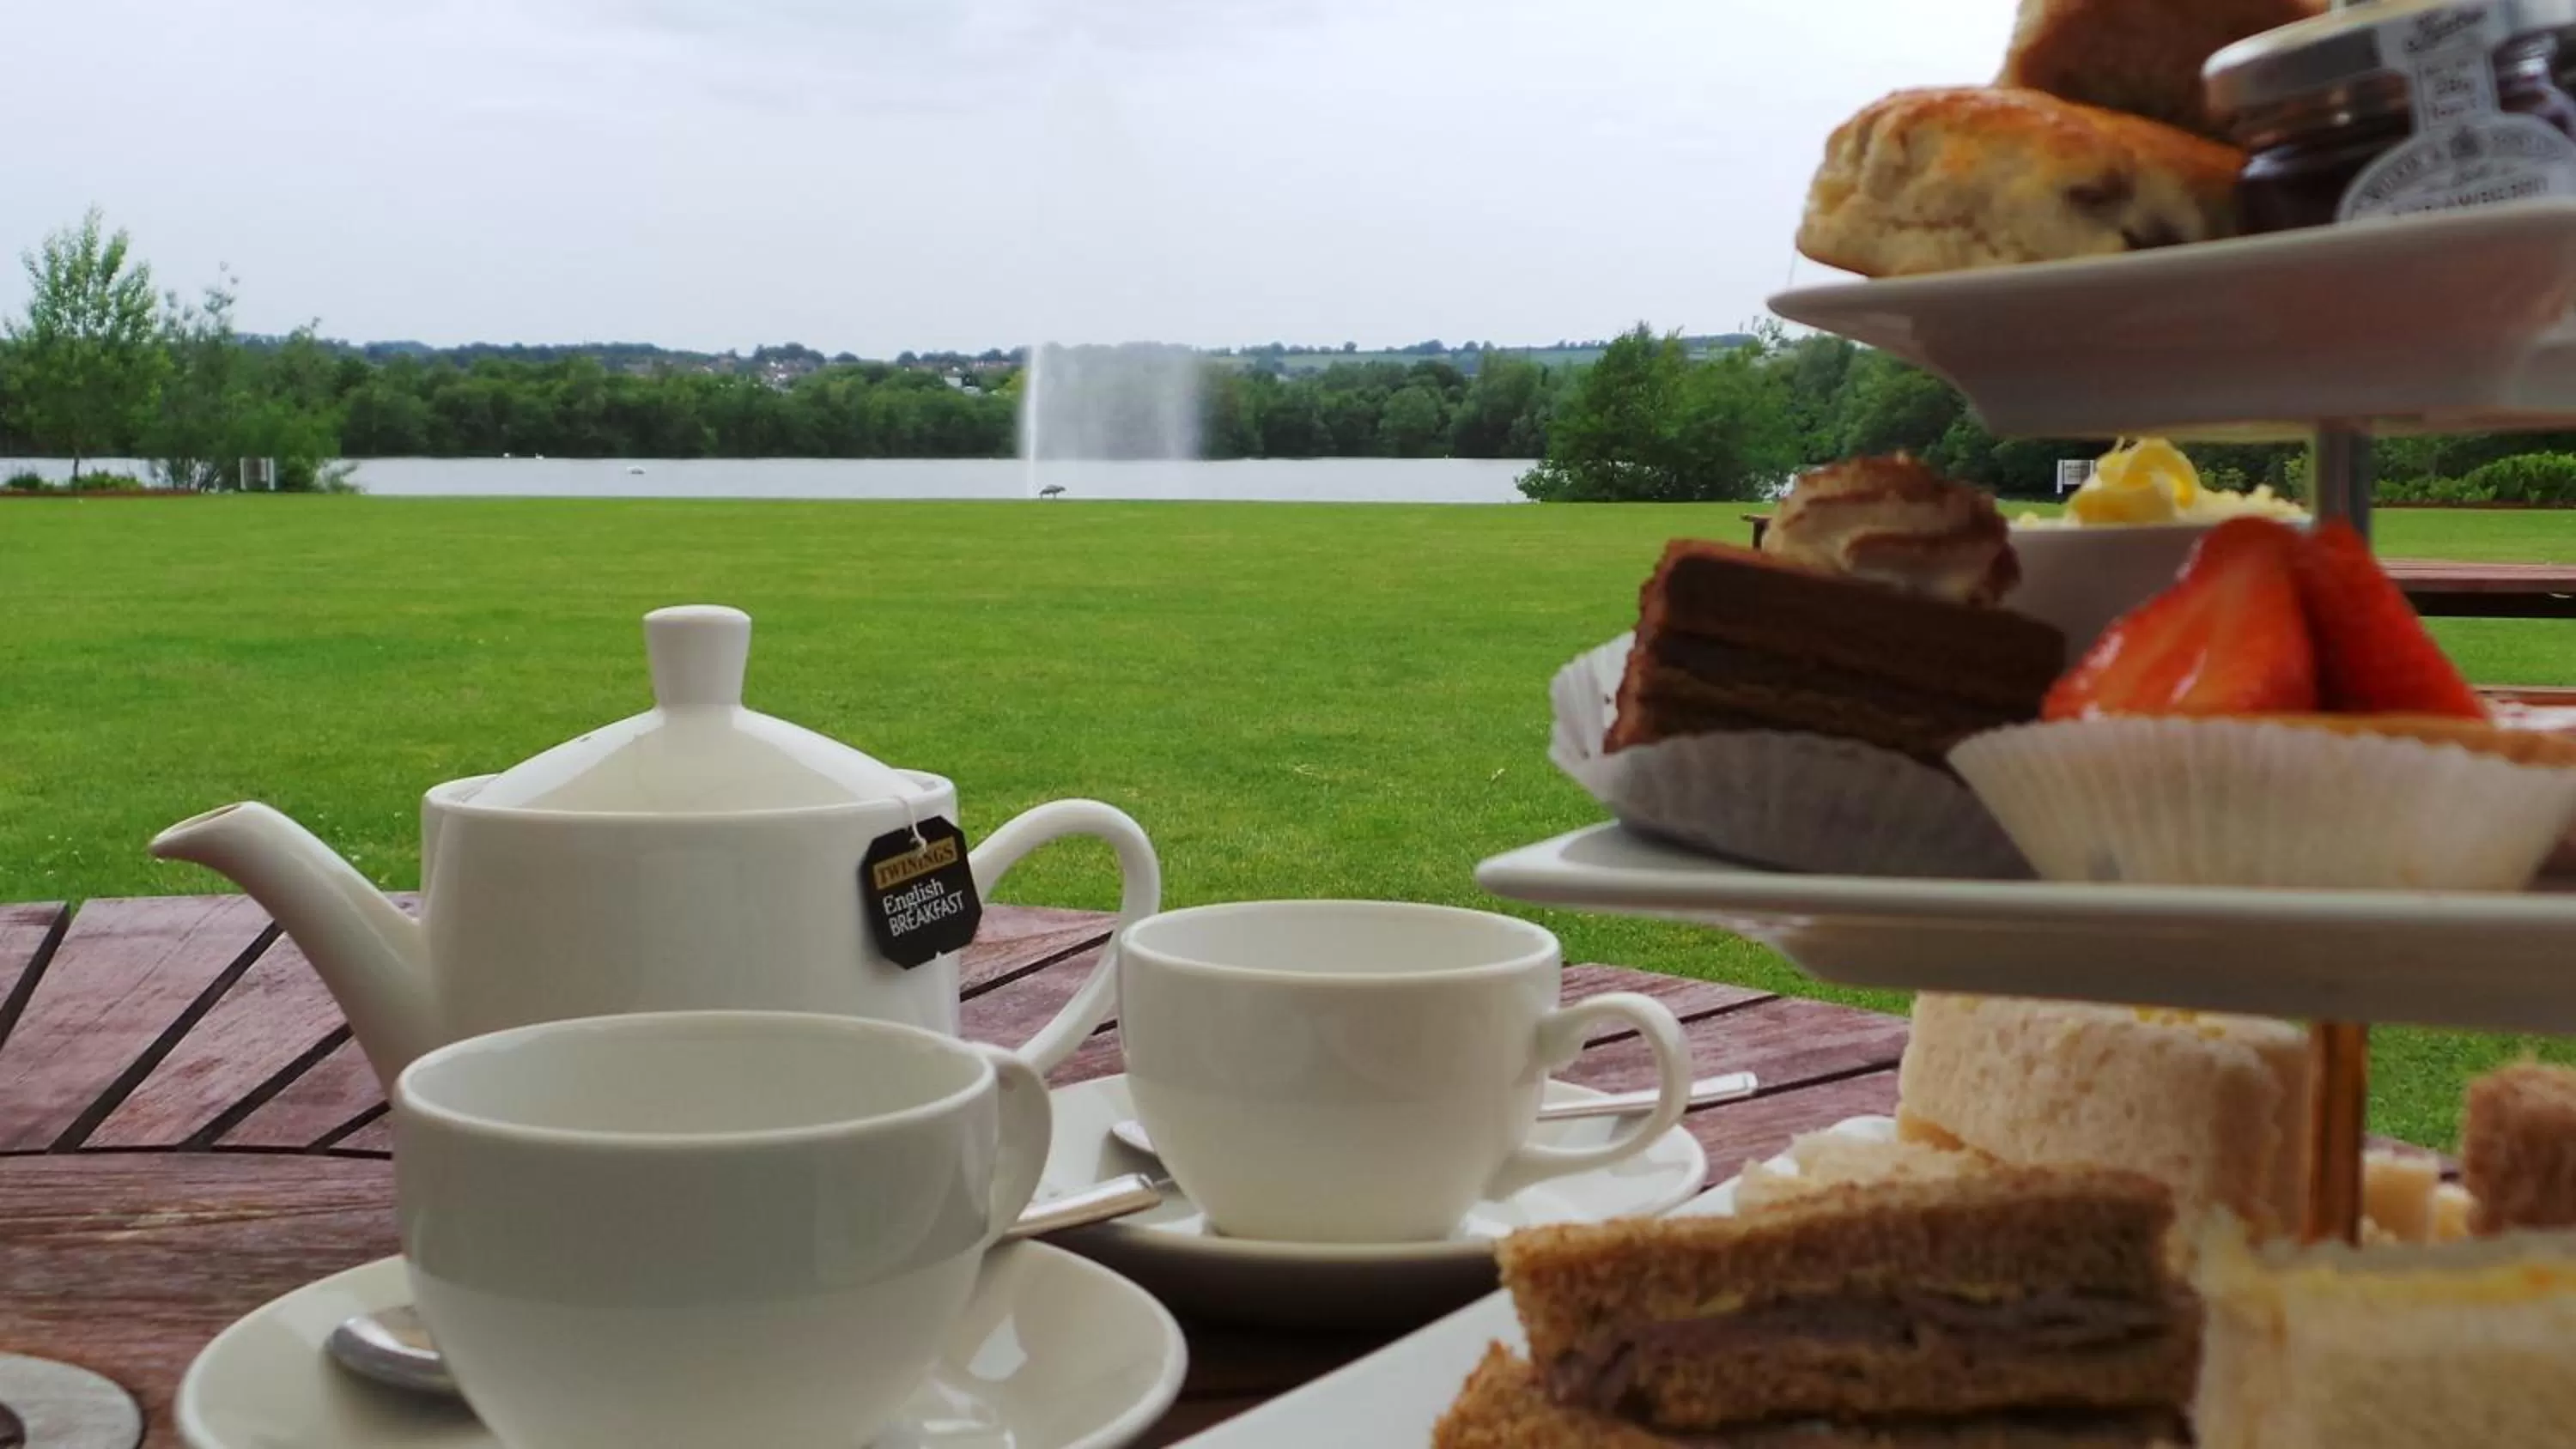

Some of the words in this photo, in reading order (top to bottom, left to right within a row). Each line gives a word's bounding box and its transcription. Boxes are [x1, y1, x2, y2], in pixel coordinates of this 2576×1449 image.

[878, 846, 955, 885] TWININGS
[883, 877, 945, 915] English
[888, 890, 963, 937] BREAKFAST
